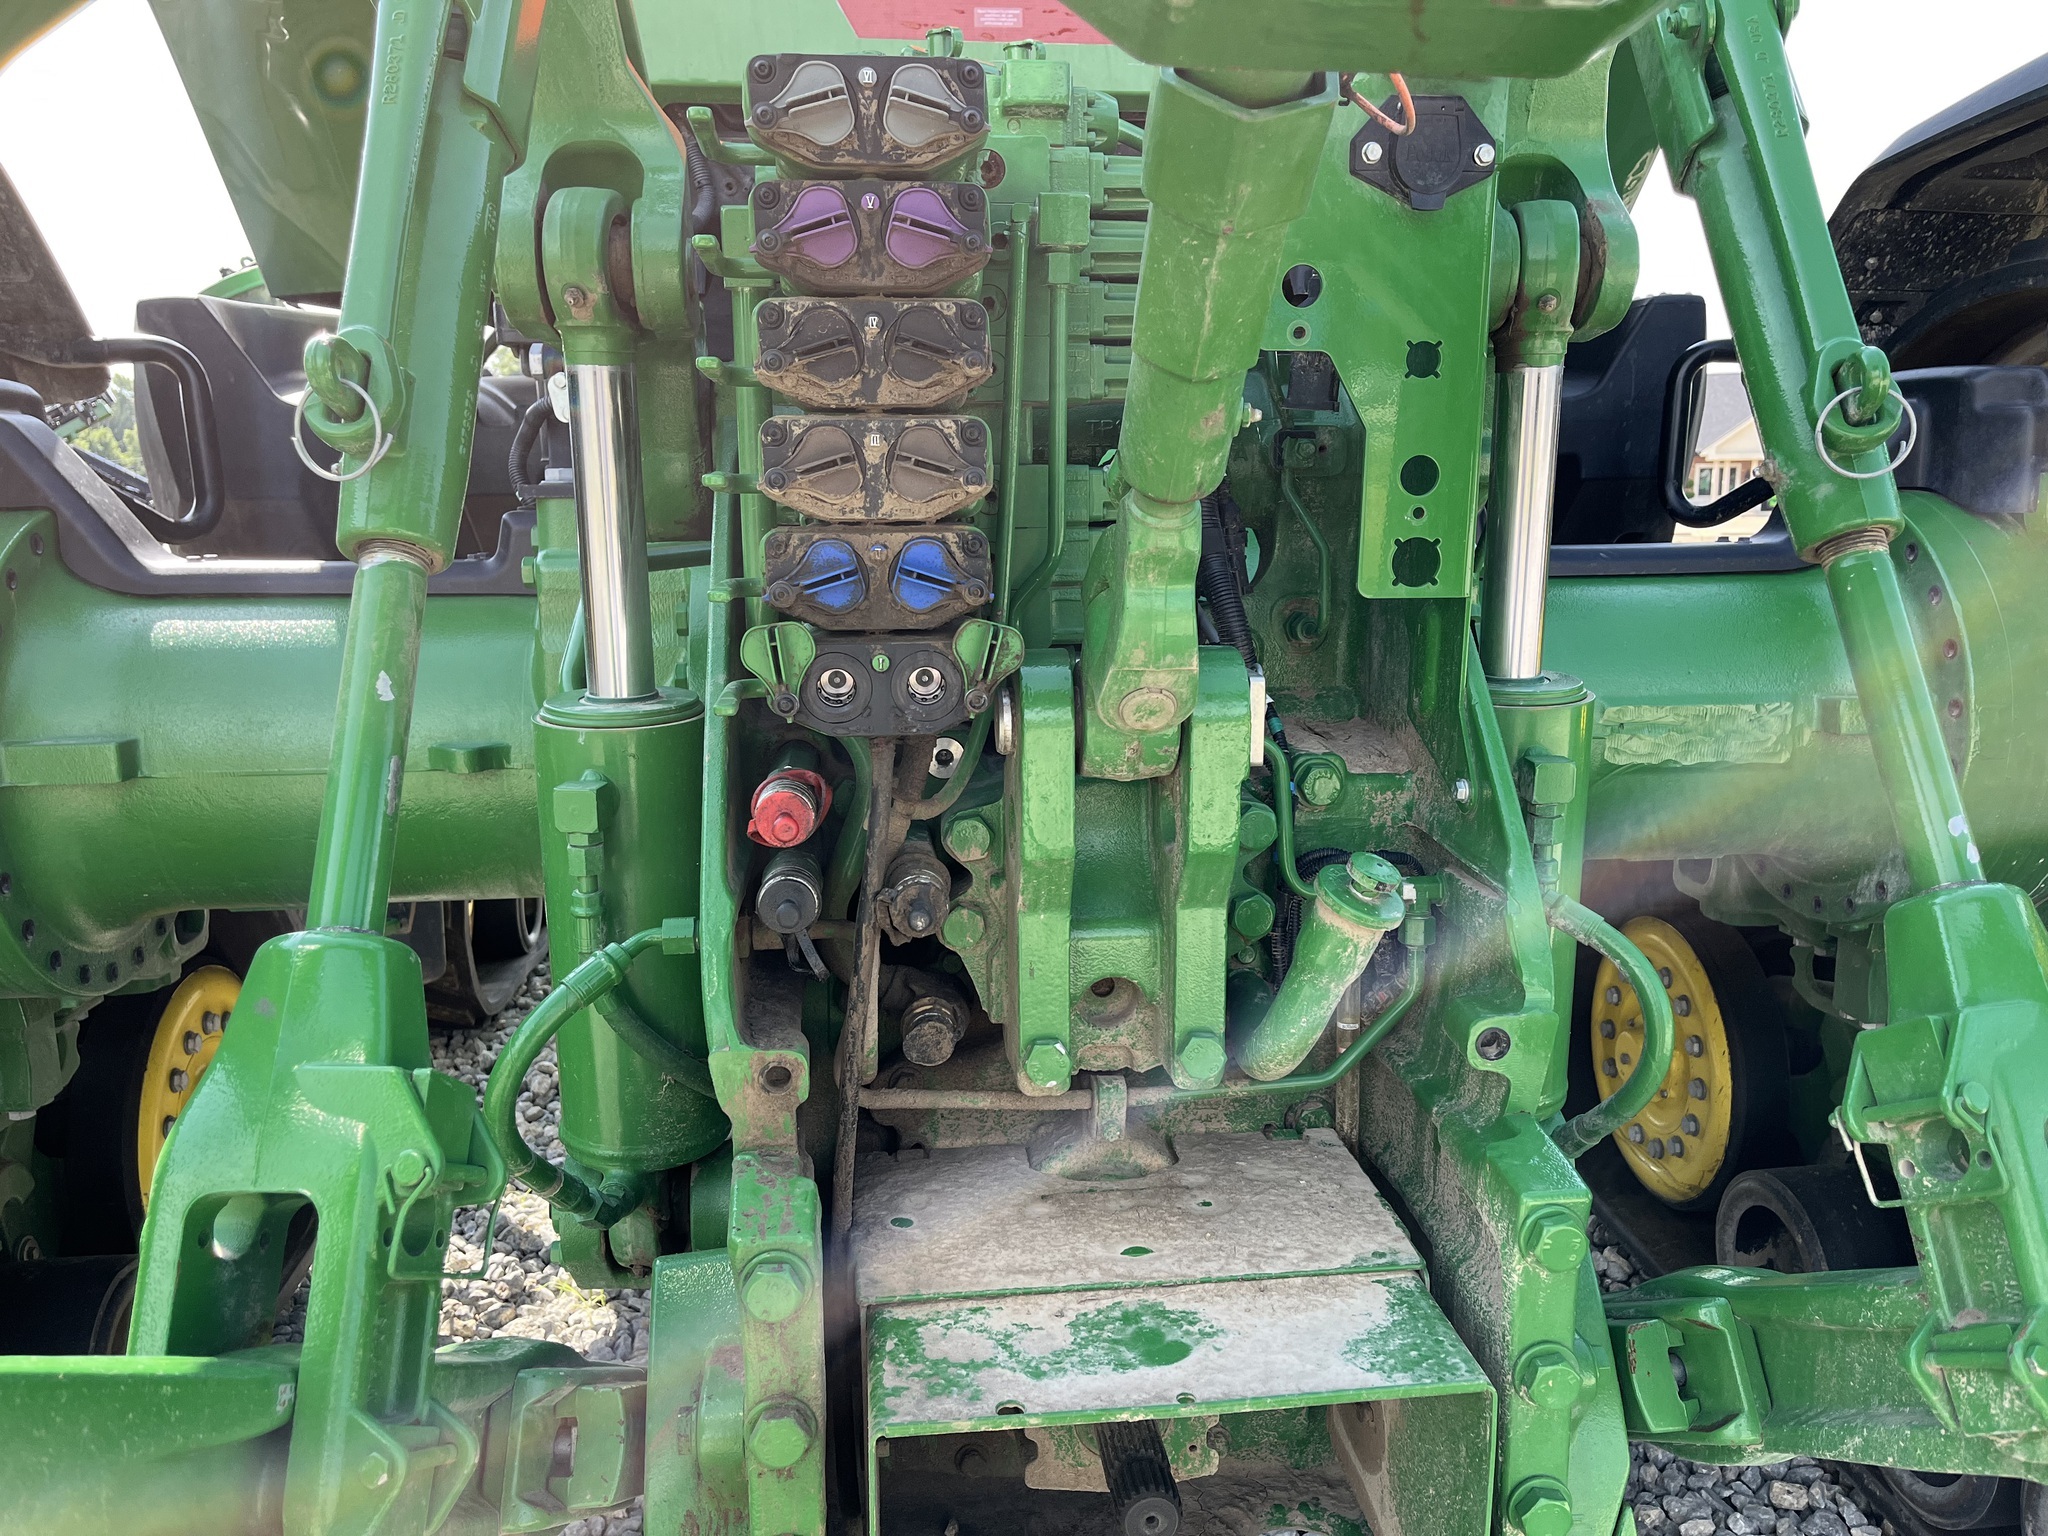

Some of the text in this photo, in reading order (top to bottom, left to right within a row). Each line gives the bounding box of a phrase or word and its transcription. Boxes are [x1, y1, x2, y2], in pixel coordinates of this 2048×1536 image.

[382, 34, 405, 105] R280371
[863, 70, 873, 83] VI
[865, 195, 875, 209] V
[869, 316, 878, 329] IV
